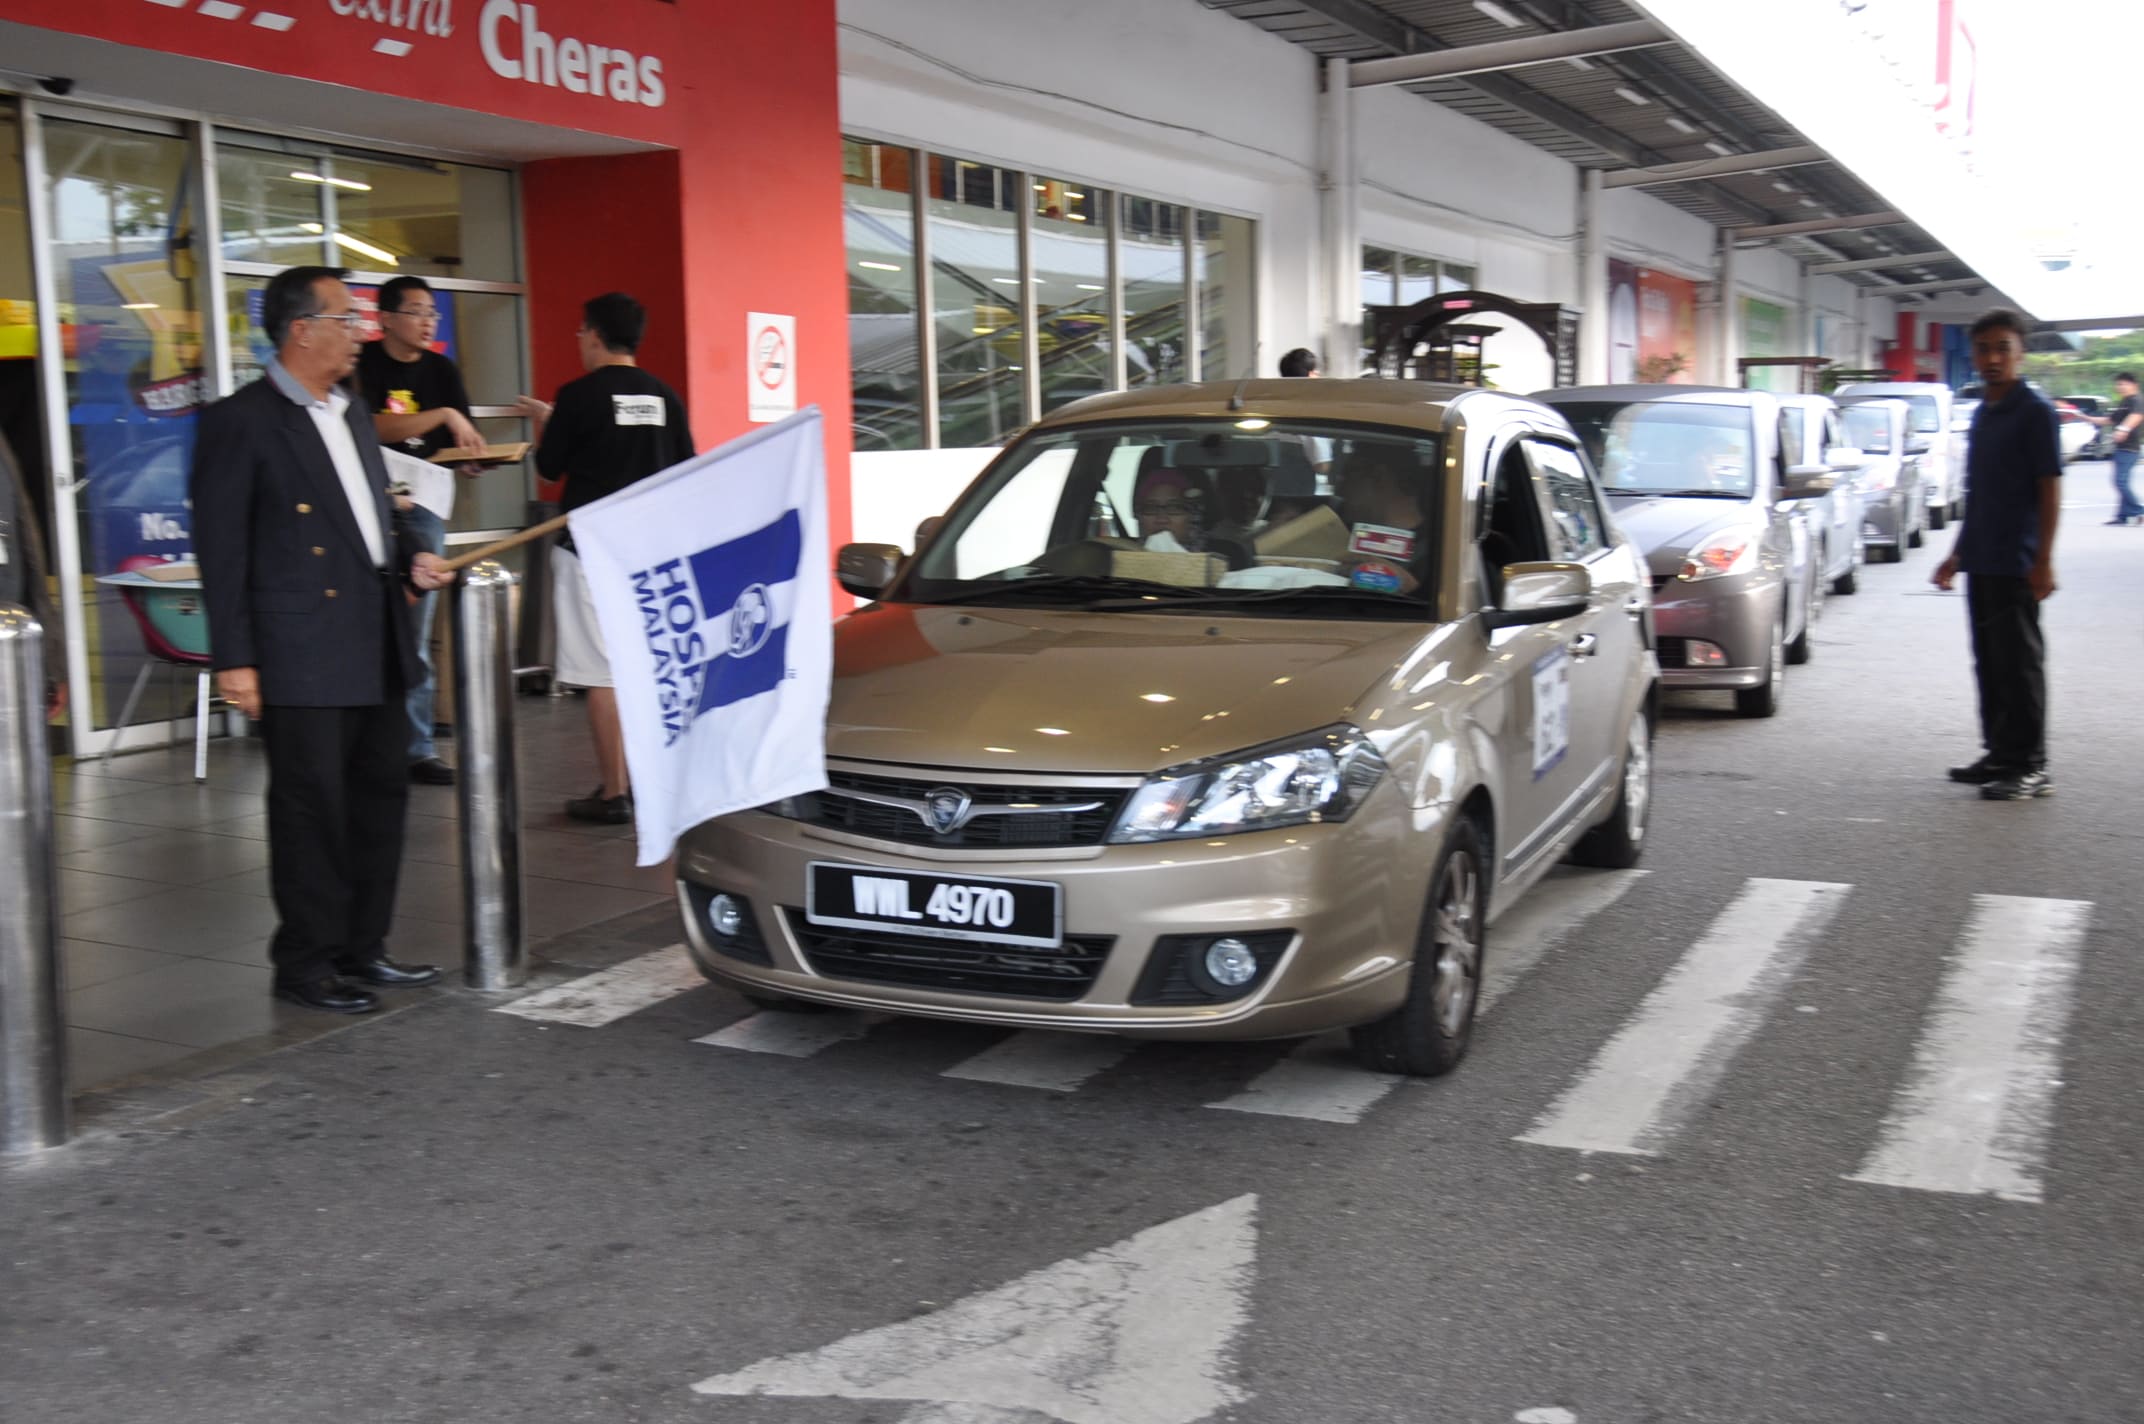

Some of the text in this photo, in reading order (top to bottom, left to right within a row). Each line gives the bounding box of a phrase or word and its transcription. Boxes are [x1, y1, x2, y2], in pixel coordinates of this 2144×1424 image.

[479, 0, 666, 107] Cheras
[630, 569, 681, 748] MALAYSIA
[926, 883, 1015, 928] 4970
